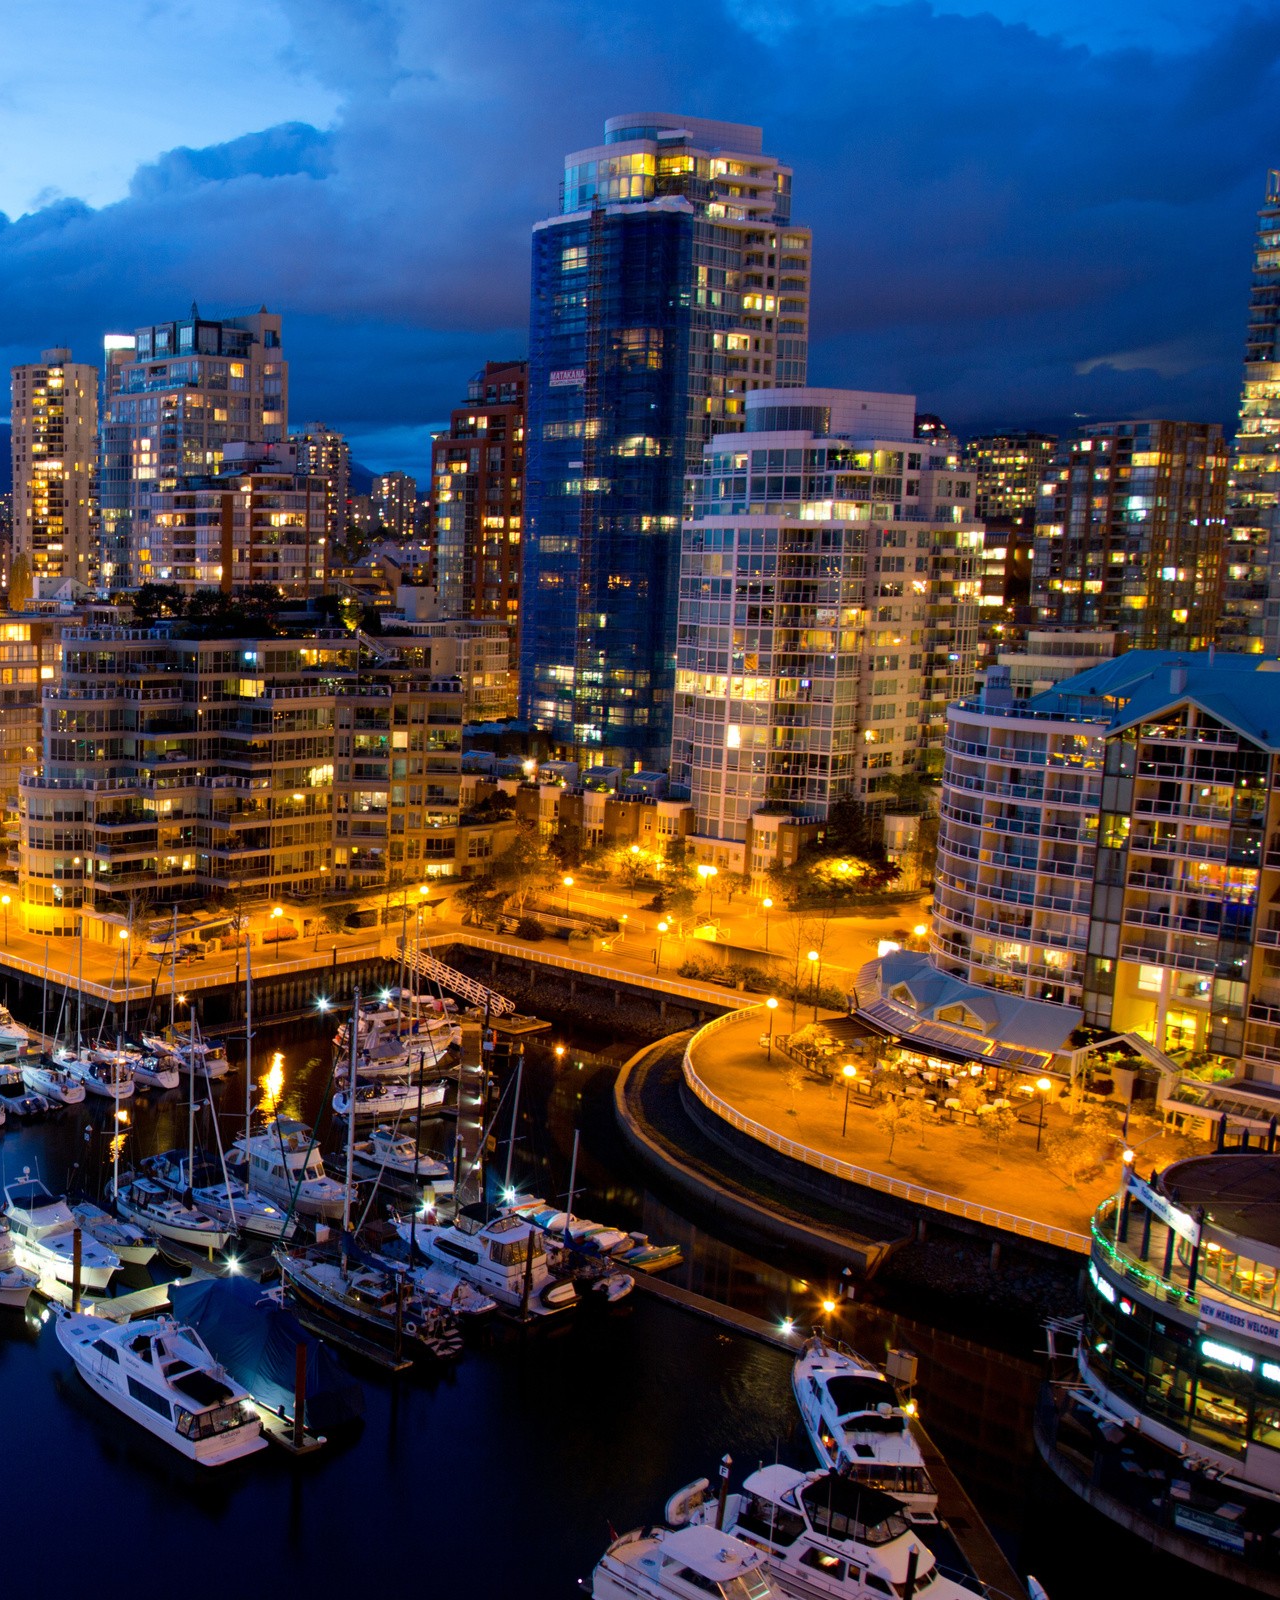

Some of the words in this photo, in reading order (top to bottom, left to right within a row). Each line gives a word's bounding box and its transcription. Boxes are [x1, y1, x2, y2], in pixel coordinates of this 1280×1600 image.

[550, 370, 585, 380] MATAKANA
[1201, 1304, 1215, 1316] NEW
[1216, 1310, 1245, 1328] MEMBERS
[1247, 1320, 1279, 1339] WELCOME
